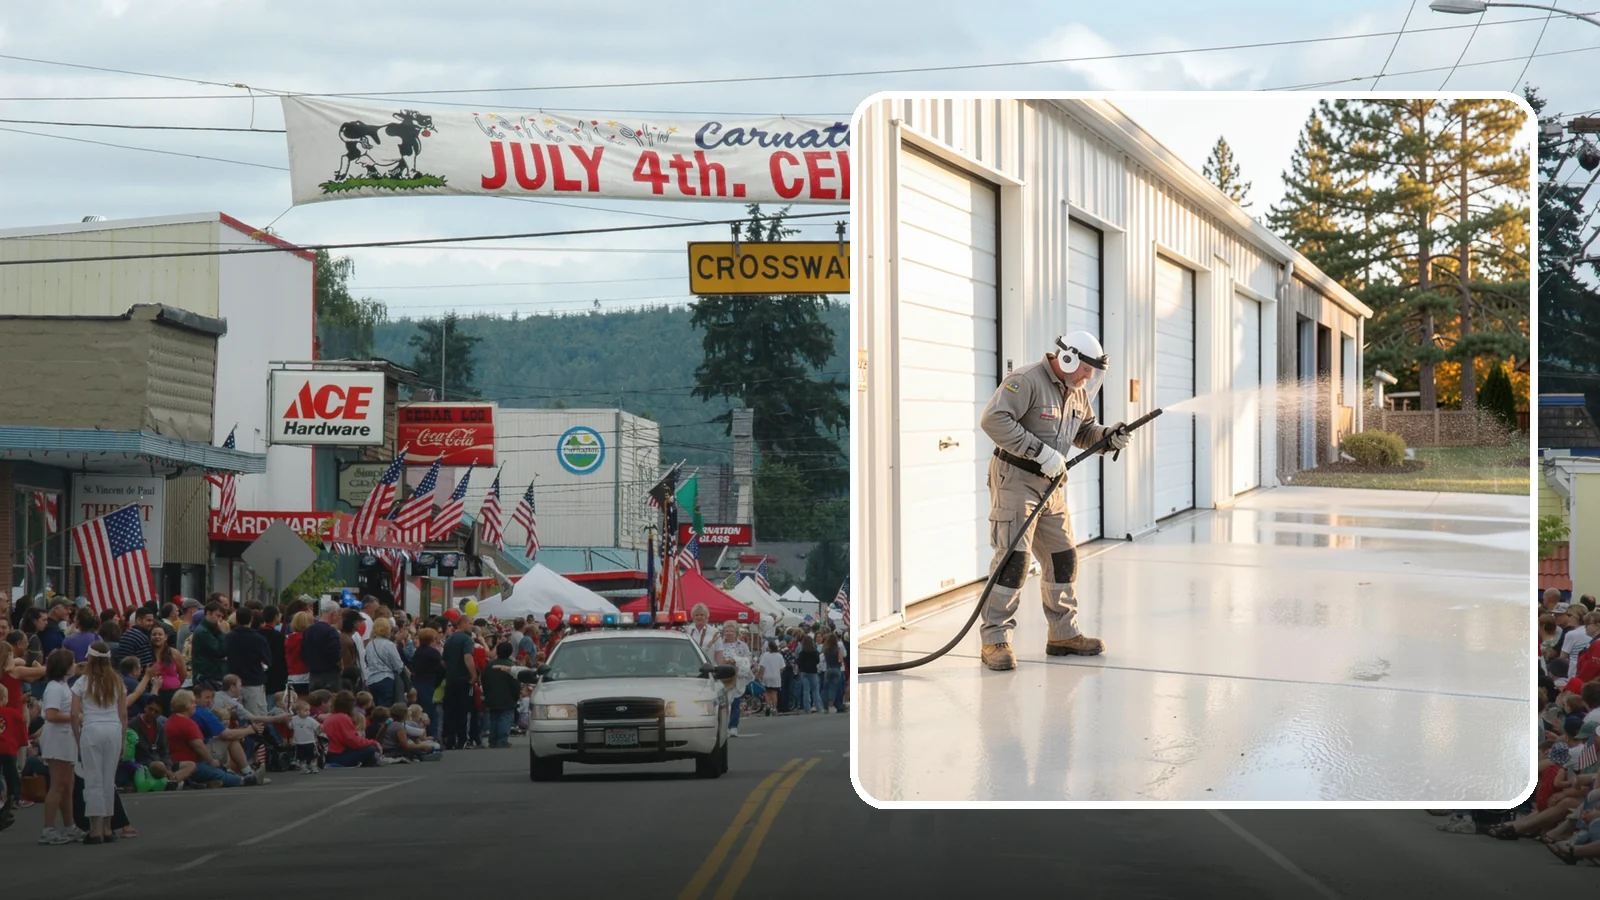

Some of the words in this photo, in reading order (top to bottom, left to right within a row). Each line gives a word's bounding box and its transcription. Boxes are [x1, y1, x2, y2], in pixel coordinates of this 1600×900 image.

[481, 141, 605, 192] JULY
[632, 150, 746, 197] 4th.
[697, 254, 850, 280] CROSSWA
[283, 380, 373, 419] ACE
[406, 409, 452, 421] CEDAR
[283, 421, 371, 436] Hardware
[416, 428, 476, 447] Coca-Cola
[353, 467, 385, 480] Simpl
[96, 486, 124, 494] Vincent
[126, 486, 135, 495] de
[137, 486, 155, 495] Paul
[81, 503, 154, 522] THRT
[213, 516, 331, 535] HARDARE
[688, 526, 741, 535] CRNATION
[699, 535, 730, 543] GLASS
